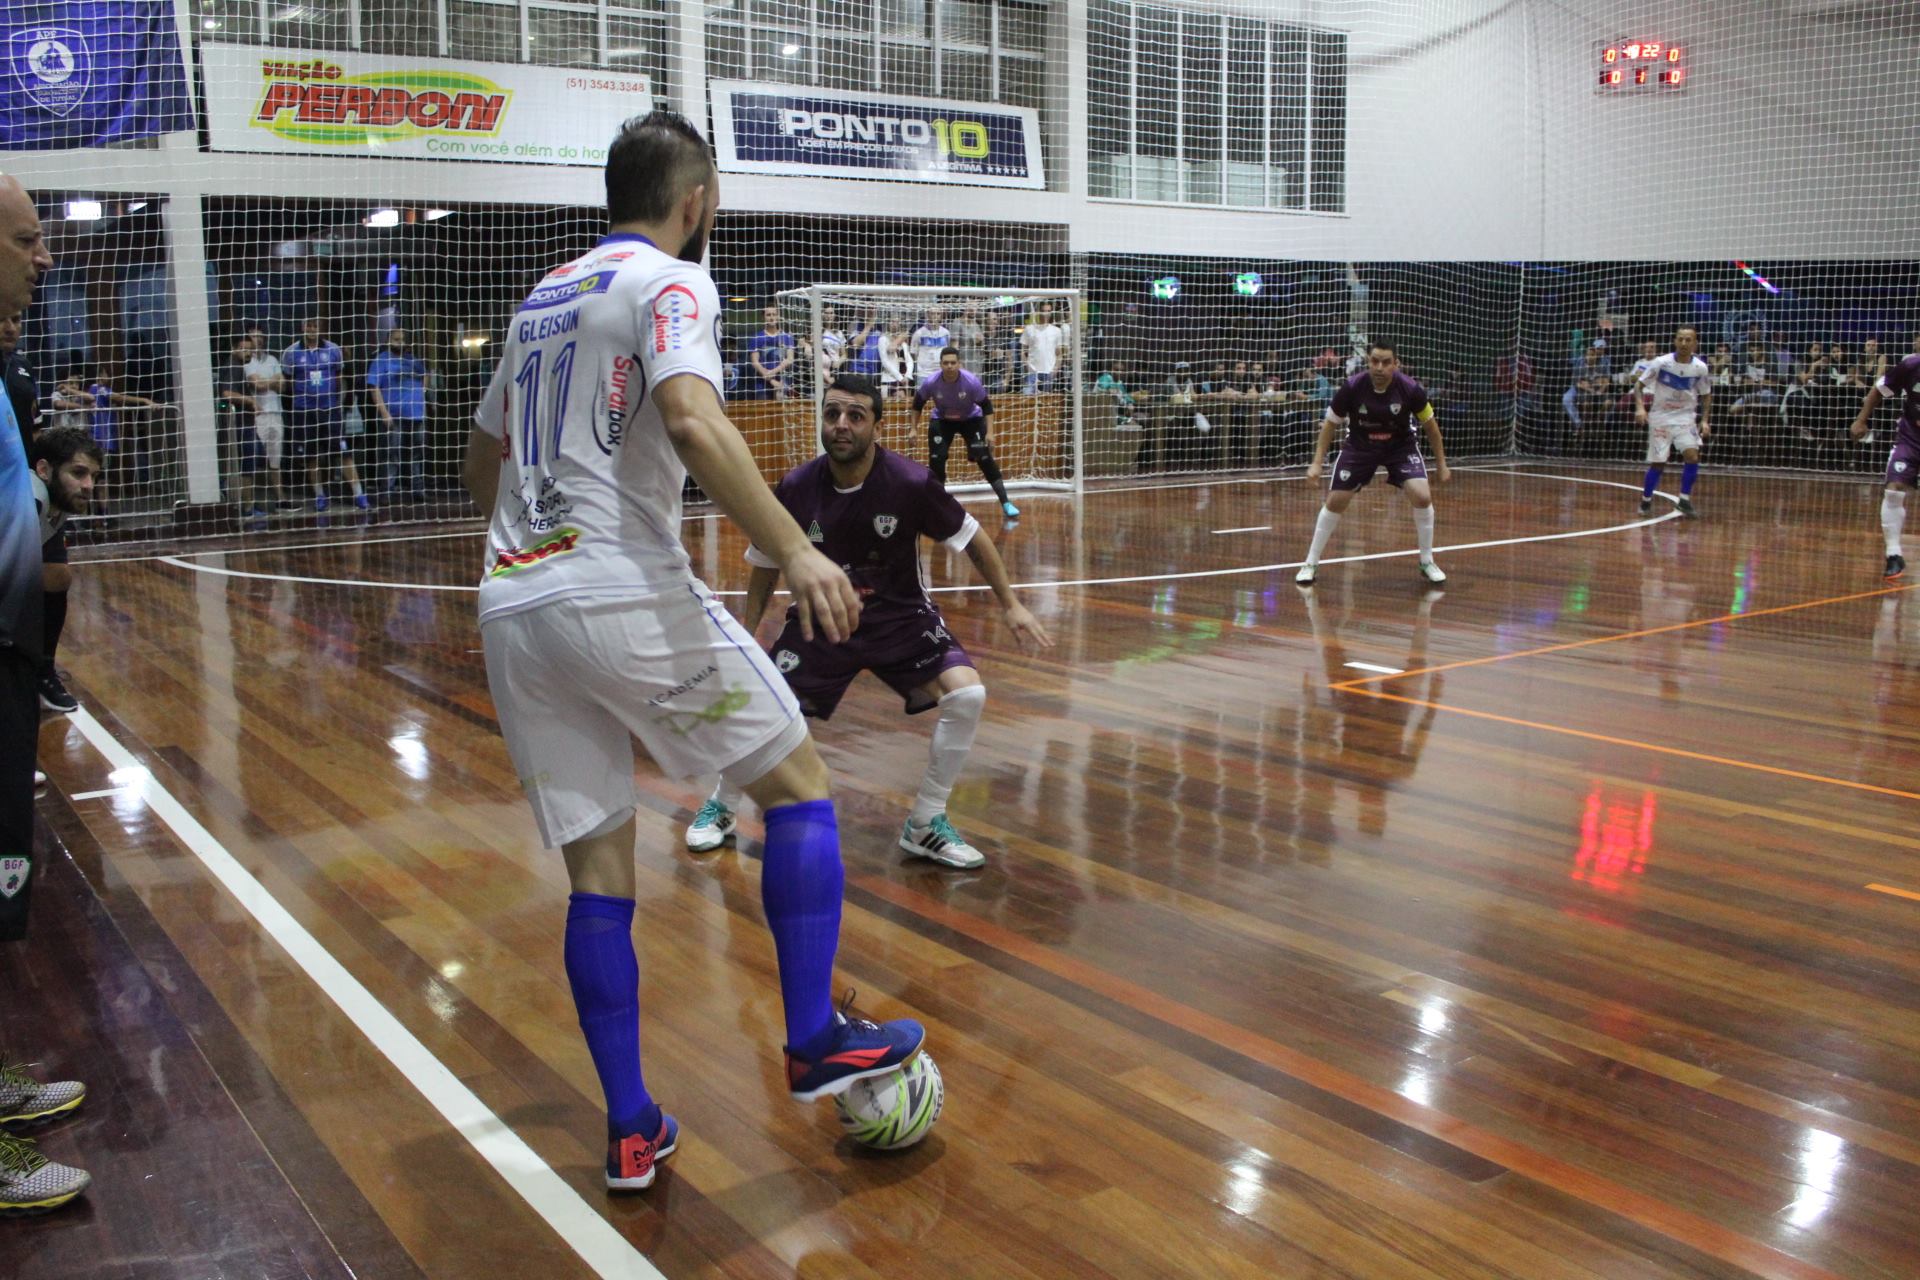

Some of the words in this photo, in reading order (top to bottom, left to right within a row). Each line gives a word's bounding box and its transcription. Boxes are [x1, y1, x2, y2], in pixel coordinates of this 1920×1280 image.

[1606, 49, 1616, 62] 0
[1669, 49, 1679, 61] 0
[566, 77, 586, 90] (51)
[1611, 71, 1621, 83] 0
[1670, 71, 1681, 83] 0
[257, 82, 505, 131] PERBONI
[427, 138, 465, 152] Com
[470, 140, 509, 154] você
[514, 143, 552, 157] além
[558, 145, 577, 158] do
[519, 307, 580, 345] GLEISON
[515, 341, 577, 466] 11
[4, 859, 24, 870] BGF
